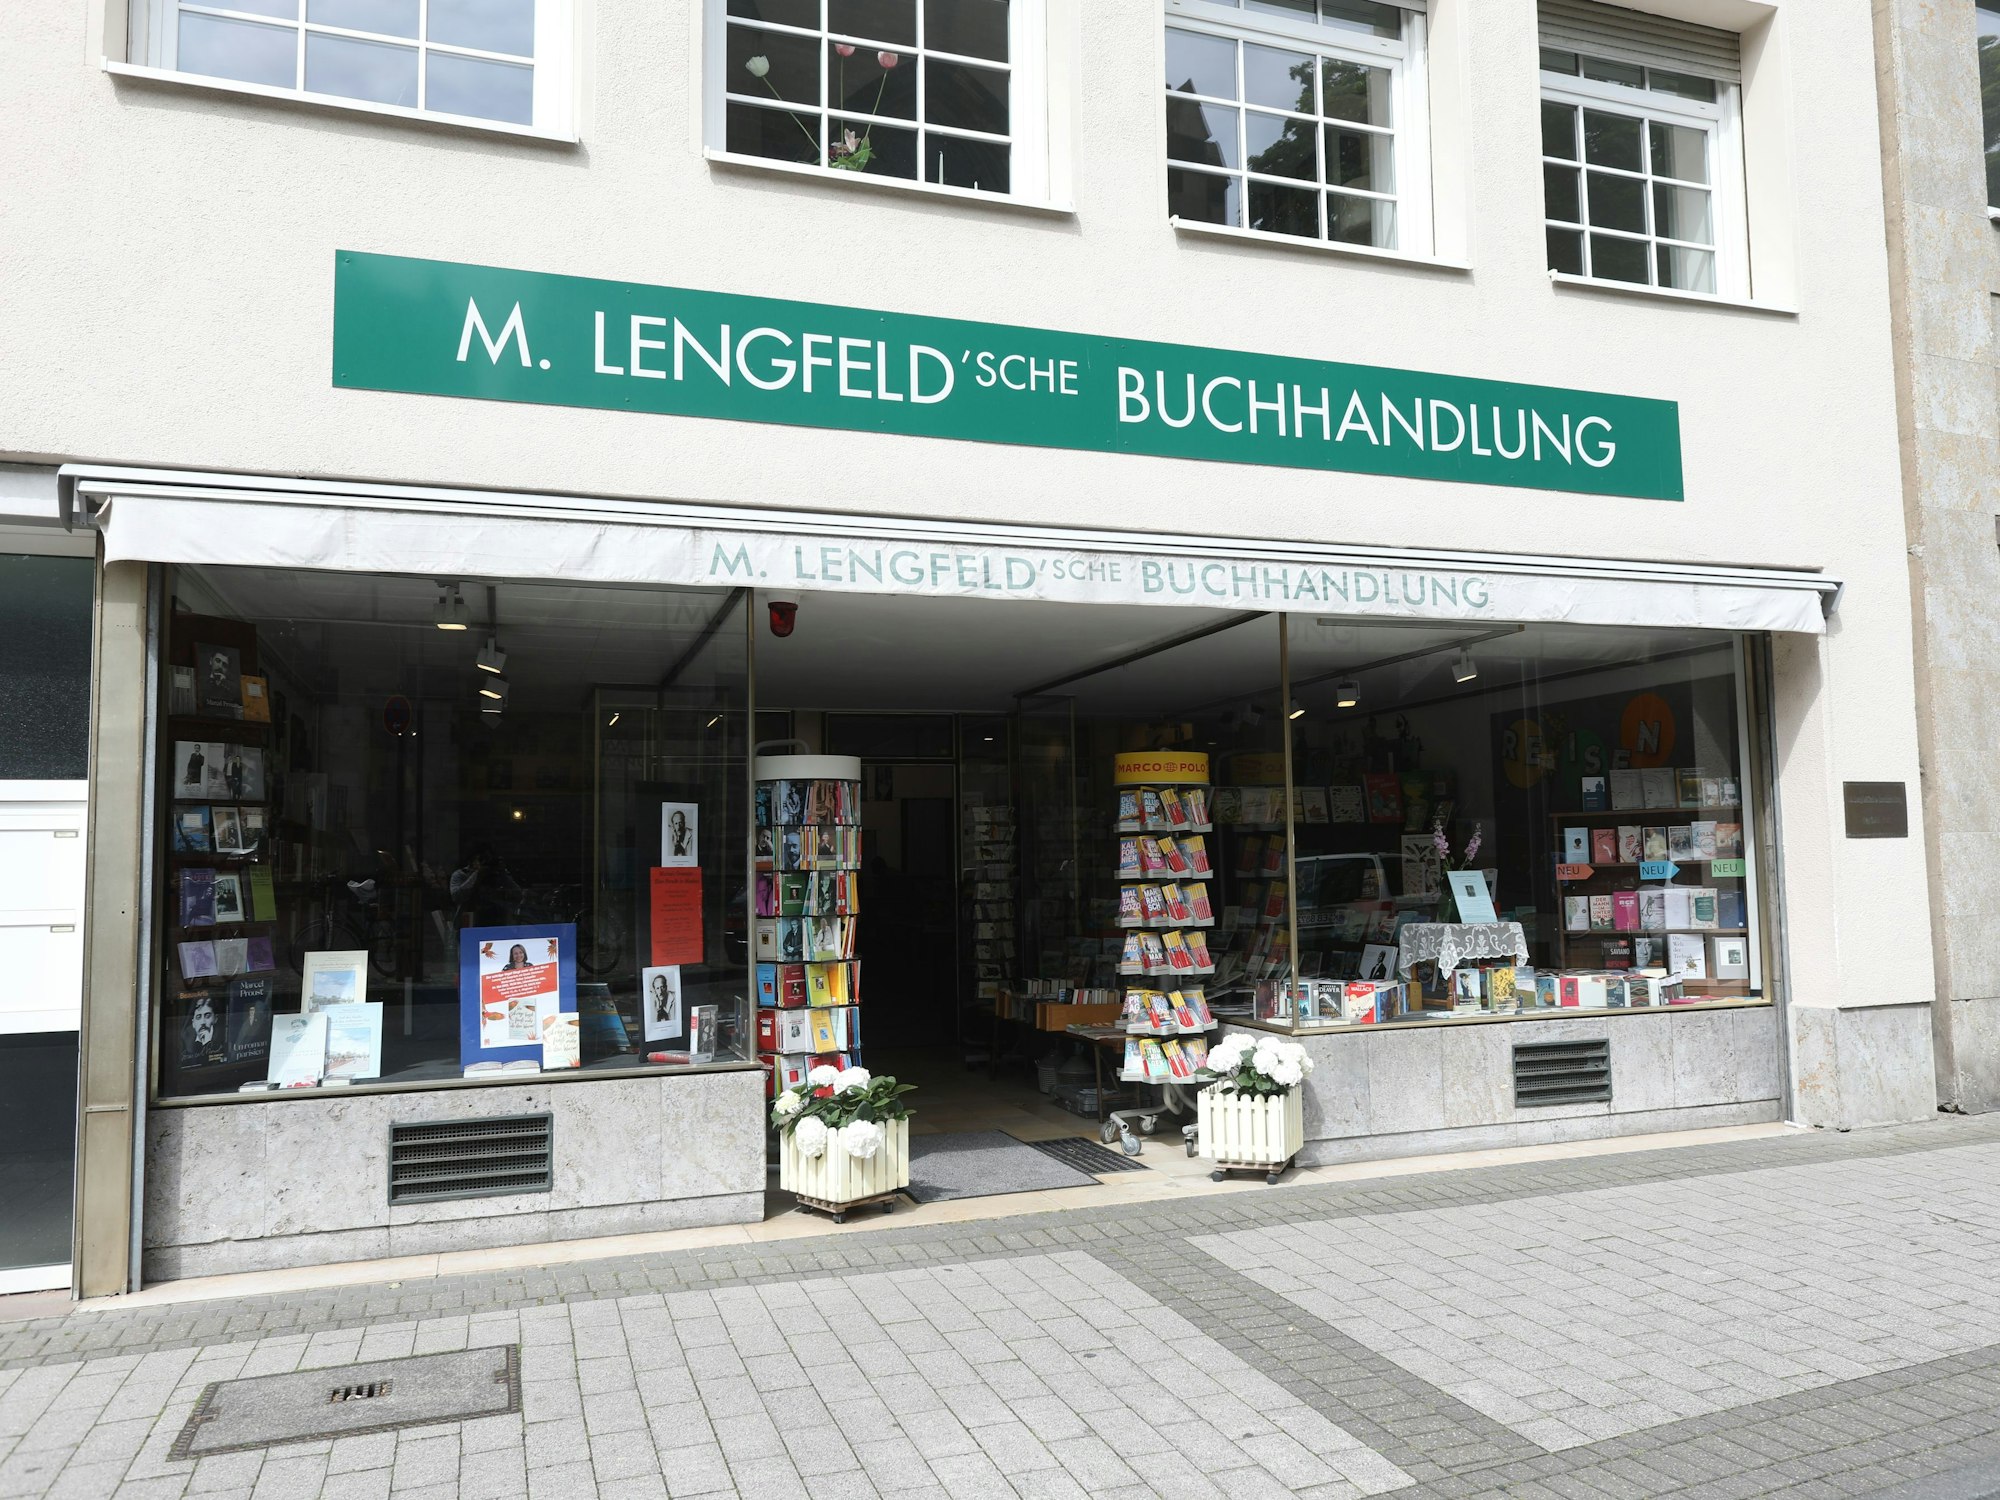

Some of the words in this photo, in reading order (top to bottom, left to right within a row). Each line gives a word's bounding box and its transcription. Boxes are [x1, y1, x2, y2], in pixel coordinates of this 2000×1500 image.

[457, 296, 551, 370] M.
[594, 311, 1079, 403] LENGFELD'SCHE
[1117, 367, 1616, 468] BUCHHANDLUNG
[710, 543, 767, 579] M.
[1141, 560, 1490, 609] BUCHHANDLUNG
[1501, 719, 1662, 775] REISEN
[1118, 762, 1162, 774] MARCO
[1179, 762, 1206, 774] POLO
[1557, 866, 1580, 875] NEU
[1641, 865, 1665, 875] NEU
[1712, 863, 1738, 873] NEU
[239, 979, 265, 991] Marcel
[239, 988, 264, 998] Proust
[1128, 994, 1140, 1005] PR
[1128, 1003, 1141, 1015] AG
[235, 1048, 264, 1061] parisien
